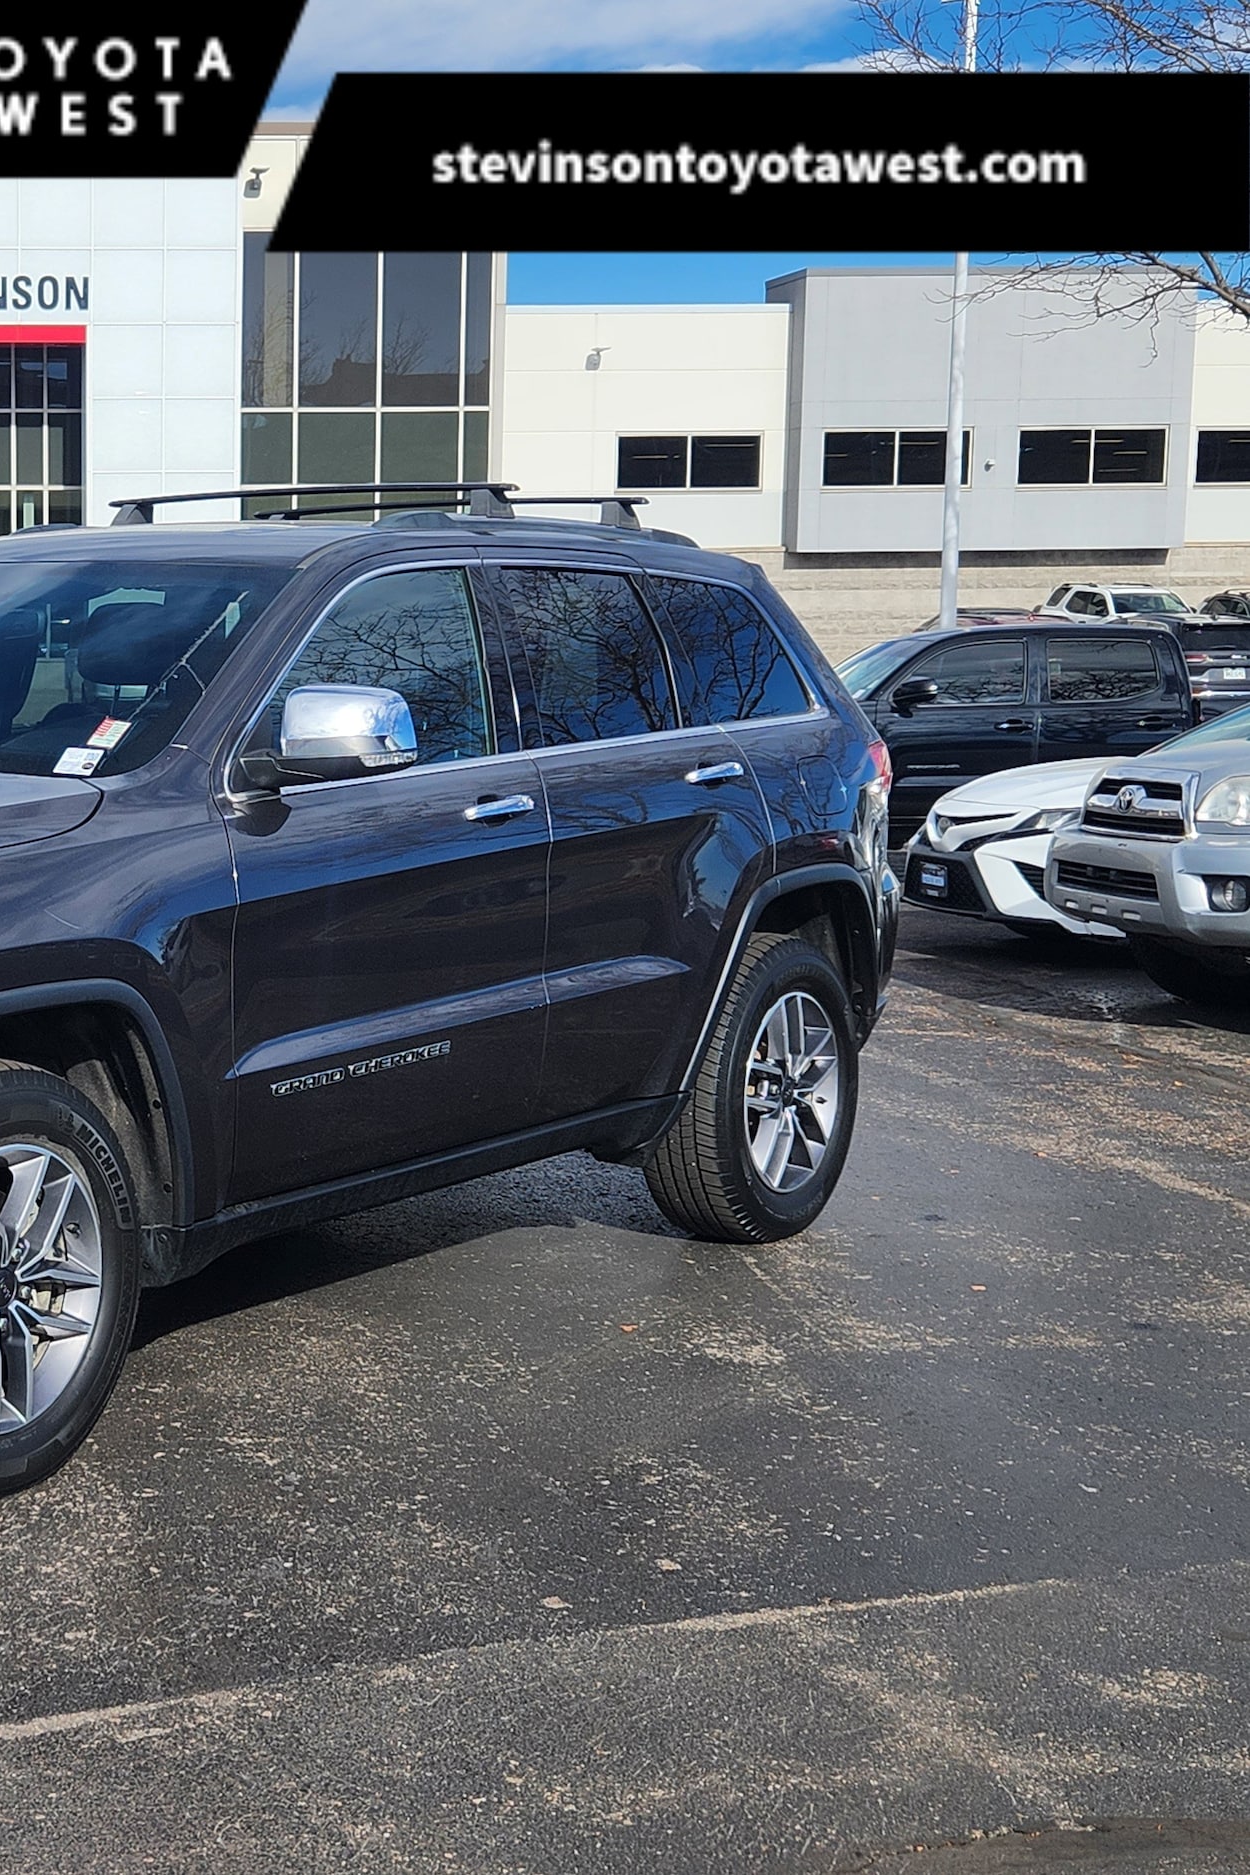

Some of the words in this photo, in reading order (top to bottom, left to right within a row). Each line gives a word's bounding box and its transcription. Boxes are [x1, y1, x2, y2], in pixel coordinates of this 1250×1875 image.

[270, 1068, 346, 1097] GRAND
[348, 1040, 452, 1078] CHEROKEE
[75, 1123, 132, 1223] MICHELIN
